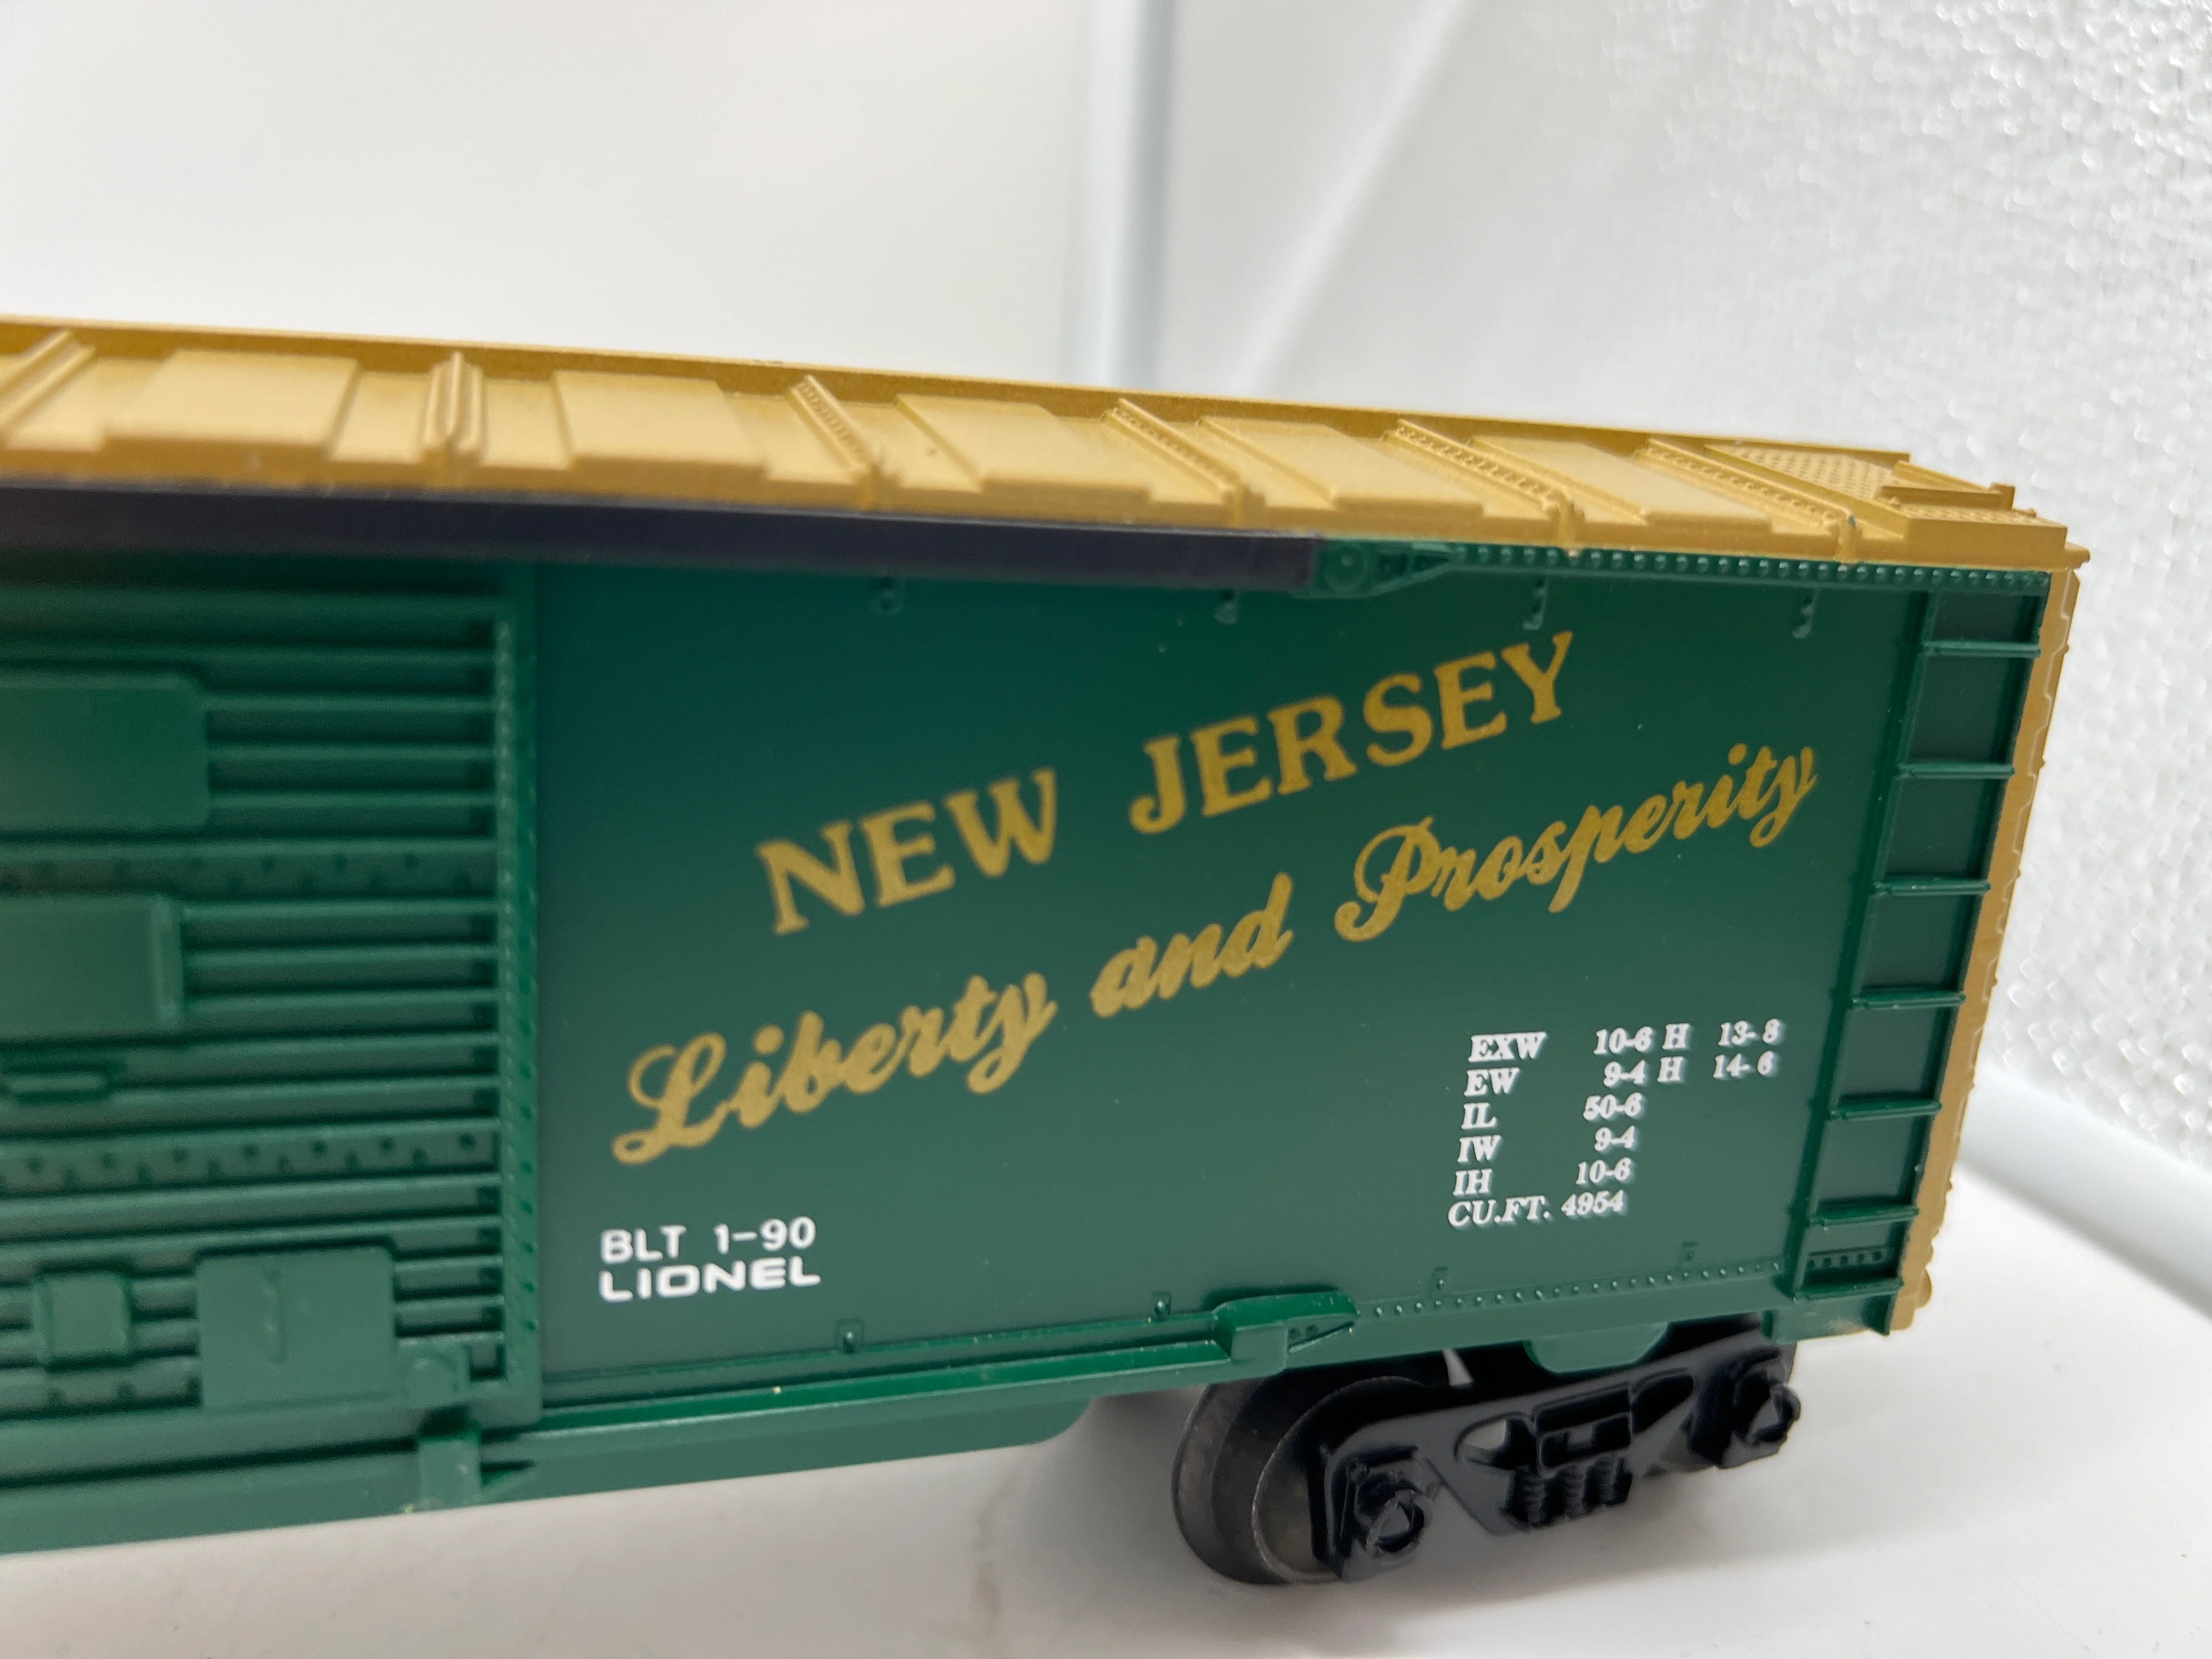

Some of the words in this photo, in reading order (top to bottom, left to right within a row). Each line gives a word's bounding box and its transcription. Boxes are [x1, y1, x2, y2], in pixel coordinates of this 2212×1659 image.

[756, 769, 1057, 935] NEW
[1132, 634, 1570, 832] JERSEY
[613, 973, 1057, 1164] Liberty
[1090, 874, 1293, 1017] and
[1335, 744, 1813, 941] Prosperity
[1468, 1031, 1547, 1063] EXW
[1662, 1023, 1691, 1051] H
[1463, 1067, 1520, 1097] EW
[1603, 1059, 1647, 1088] 9-4
[1657, 1056, 1685, 1083] H
[1460, 1102, 1497, 1130] IL
[1583, 1092, 1645, 1121] 50-6
[1457, 1135, 1502, 1164] IW
[1594, 1125, 1637, 1153] 9-4
[1452, 1168, 1493, 1197] IH
[1576, 1157, 1634, 1186] 10-6
[1448, 1195, 1551, 1228] CU.FT.
[1561, 1189, 1626, 1218] 4954
[600, 1224, 687, 1264] BLT
[714, 1216, 816, 1255] 1-90
[599, 1256, 822, 1303] LIONEL
